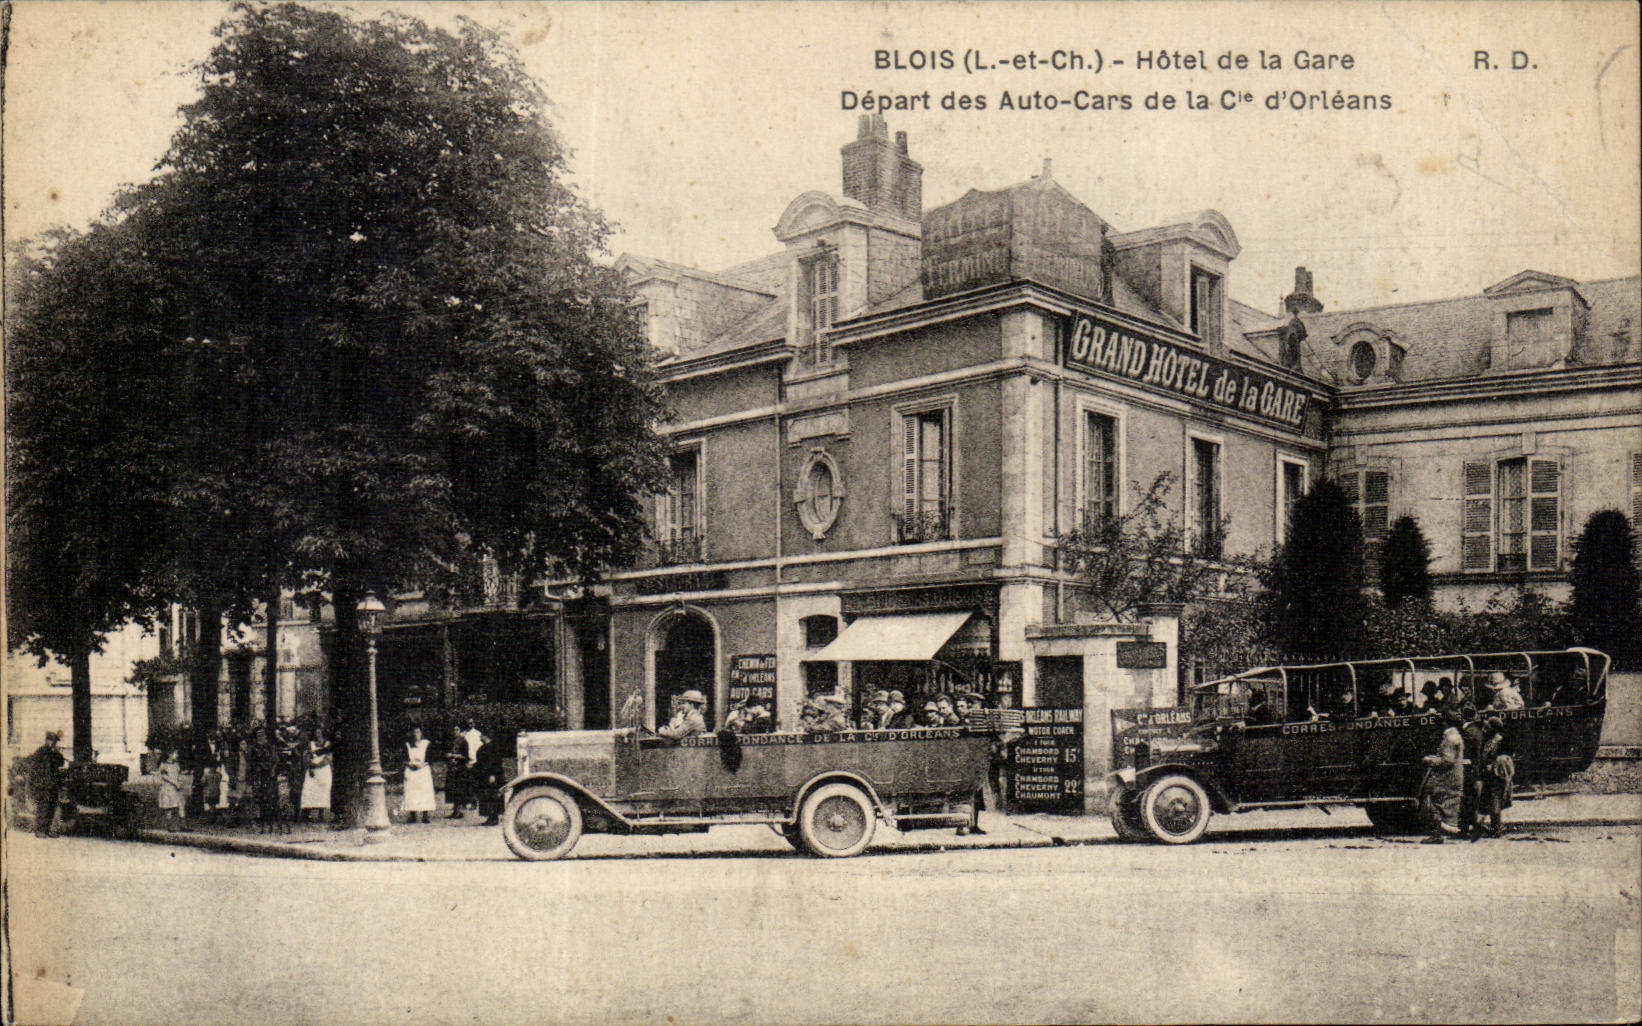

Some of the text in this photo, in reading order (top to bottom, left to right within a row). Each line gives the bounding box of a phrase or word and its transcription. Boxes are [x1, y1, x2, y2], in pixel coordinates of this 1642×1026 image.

[1072, 318, 1147, 380] GRAND
[1213, 369, 1238, 404] de
[1238, 376, 1258, 411] la
[1261, 381, 1306, 425] GARE
[1282, 716, 1437, 735] CORRESONDANCE DE
[840, 732, 856, 742] LA
